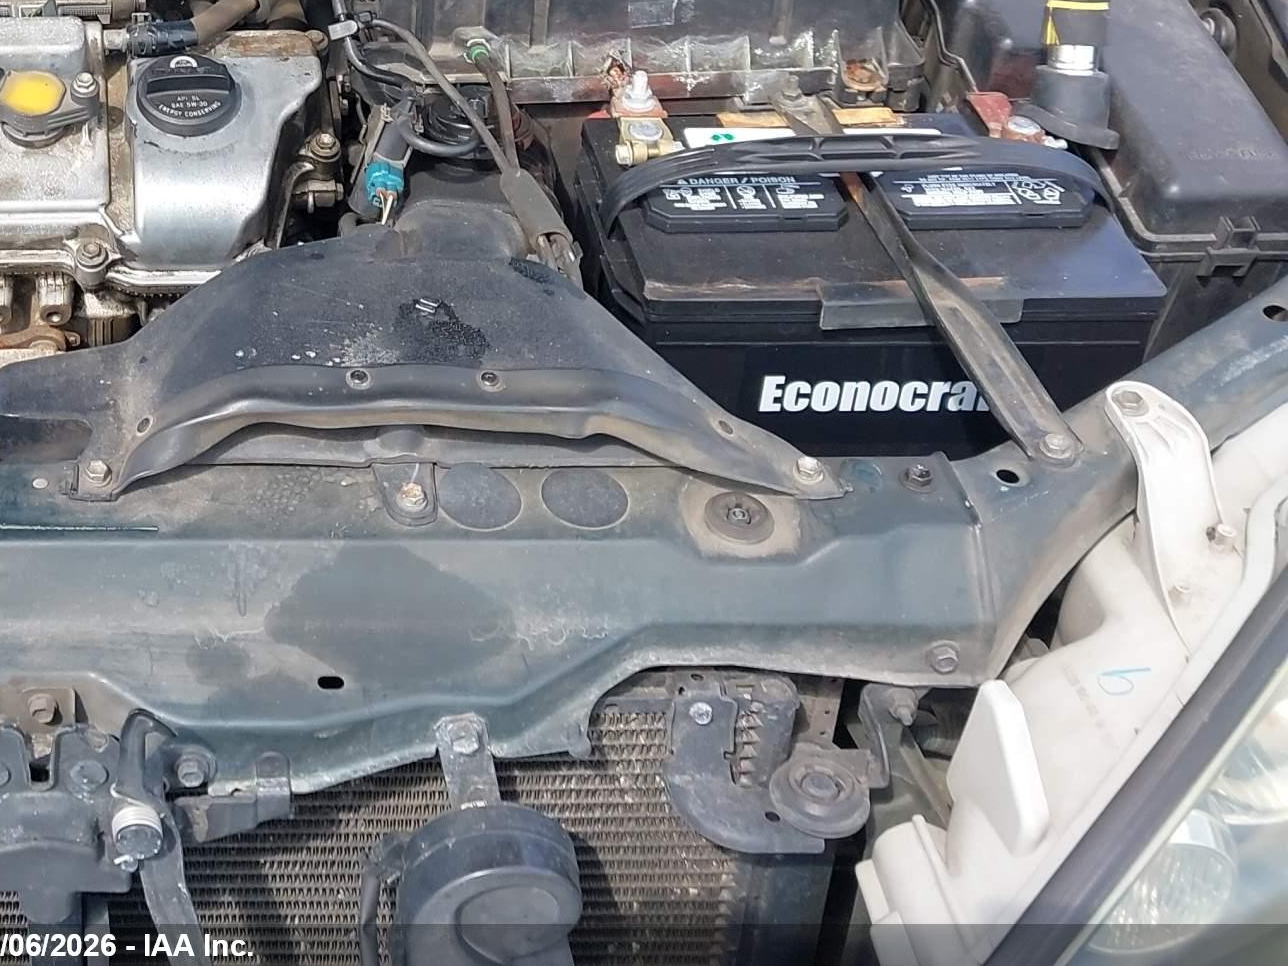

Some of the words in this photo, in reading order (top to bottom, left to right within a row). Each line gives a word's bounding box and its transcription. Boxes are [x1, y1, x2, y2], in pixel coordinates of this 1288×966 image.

[158, 104, 182, 116] ENERGY
[184, 100, 221, 117] CONSERVING
[689, 177, 738, 185] DANGER
[751, 176, 796, 184] POISON
